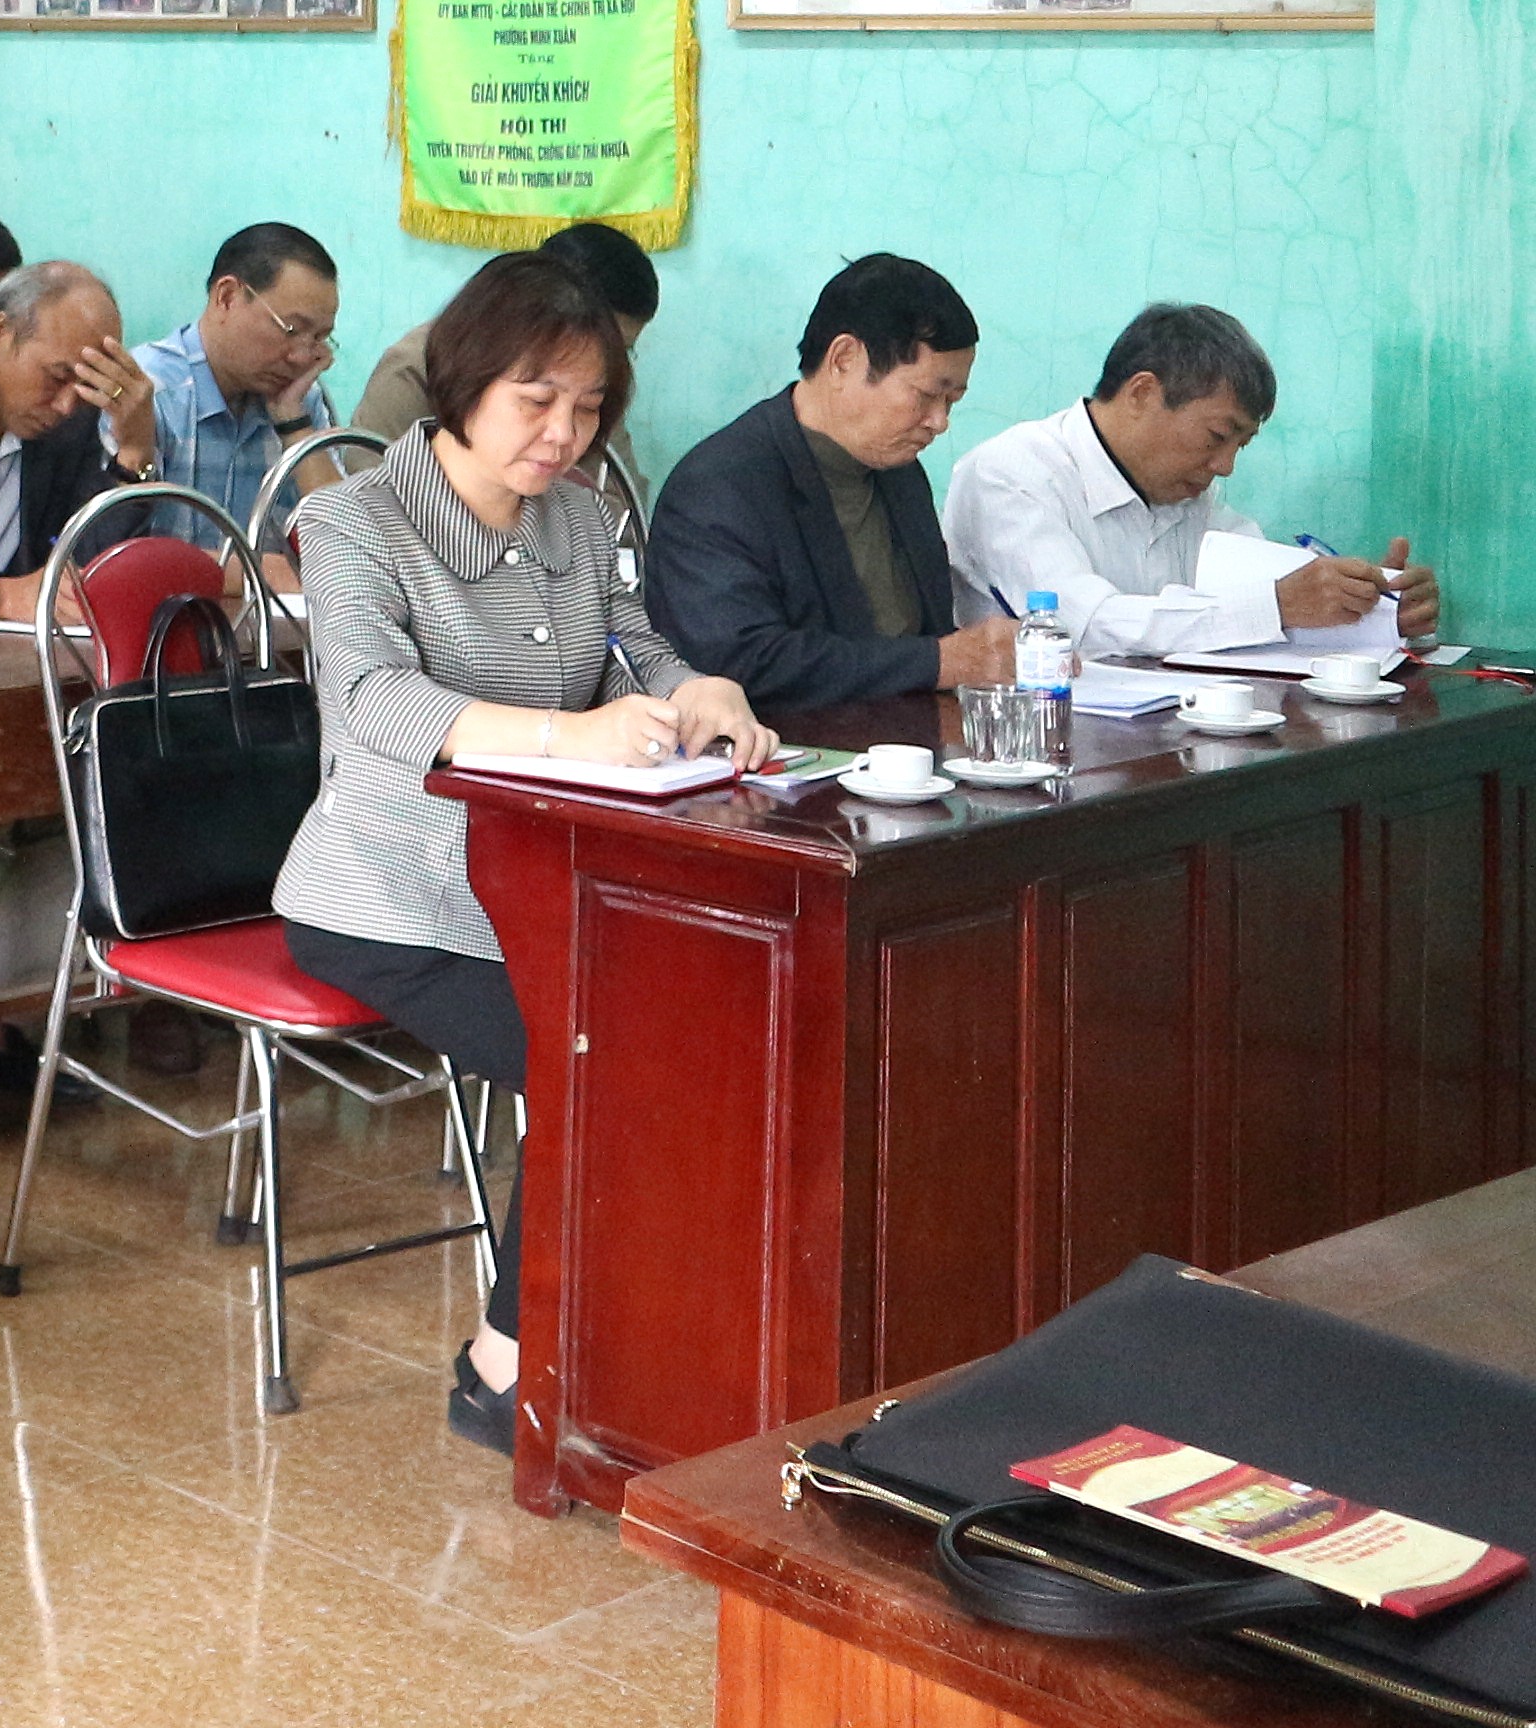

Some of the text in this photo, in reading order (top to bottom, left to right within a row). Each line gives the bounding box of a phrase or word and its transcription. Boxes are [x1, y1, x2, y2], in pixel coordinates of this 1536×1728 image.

[471, 72, 590, 104] GIẢI KHUYẾN KHÍCH
[500, 114, 567, 138] HỘI THI
[600, 139, 631, 163] NHỰA
